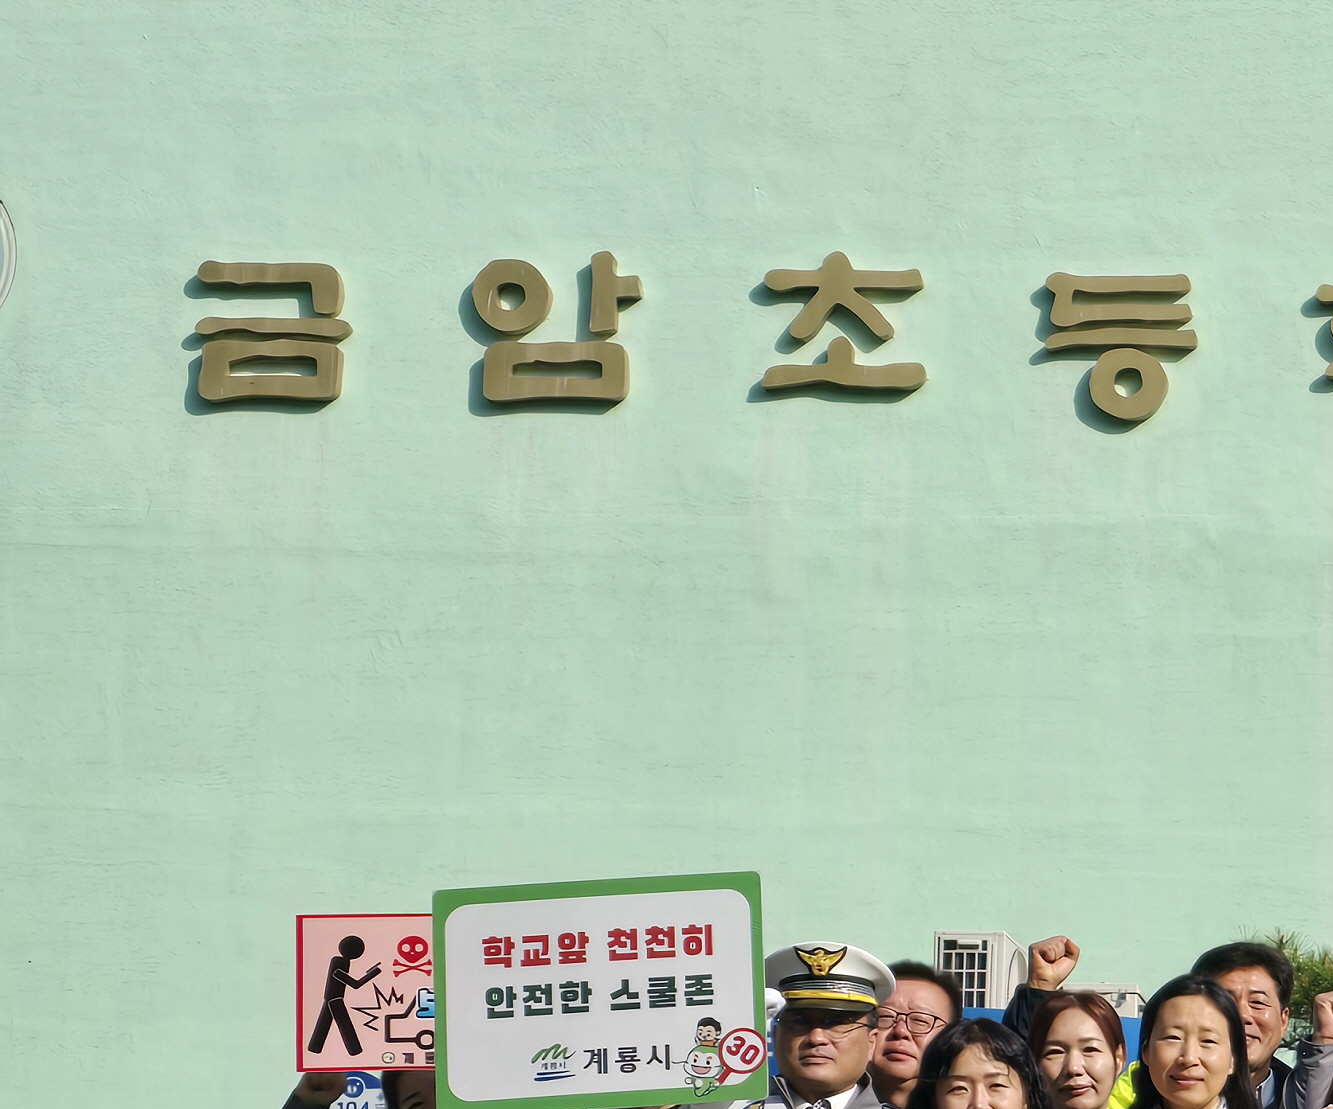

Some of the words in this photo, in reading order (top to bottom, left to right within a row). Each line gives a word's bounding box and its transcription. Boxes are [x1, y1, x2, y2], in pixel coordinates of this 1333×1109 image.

[482, 931, 589, 968] 학교앞
[607, 924, 714, 962] 천천히
[485, 980, 592, 1019] 안전한
[610, 973, 715, 1012] 스쿨존
[582, 1043, 672, 1076] 계룡시
[724, 1035, 761, 1067] 30
